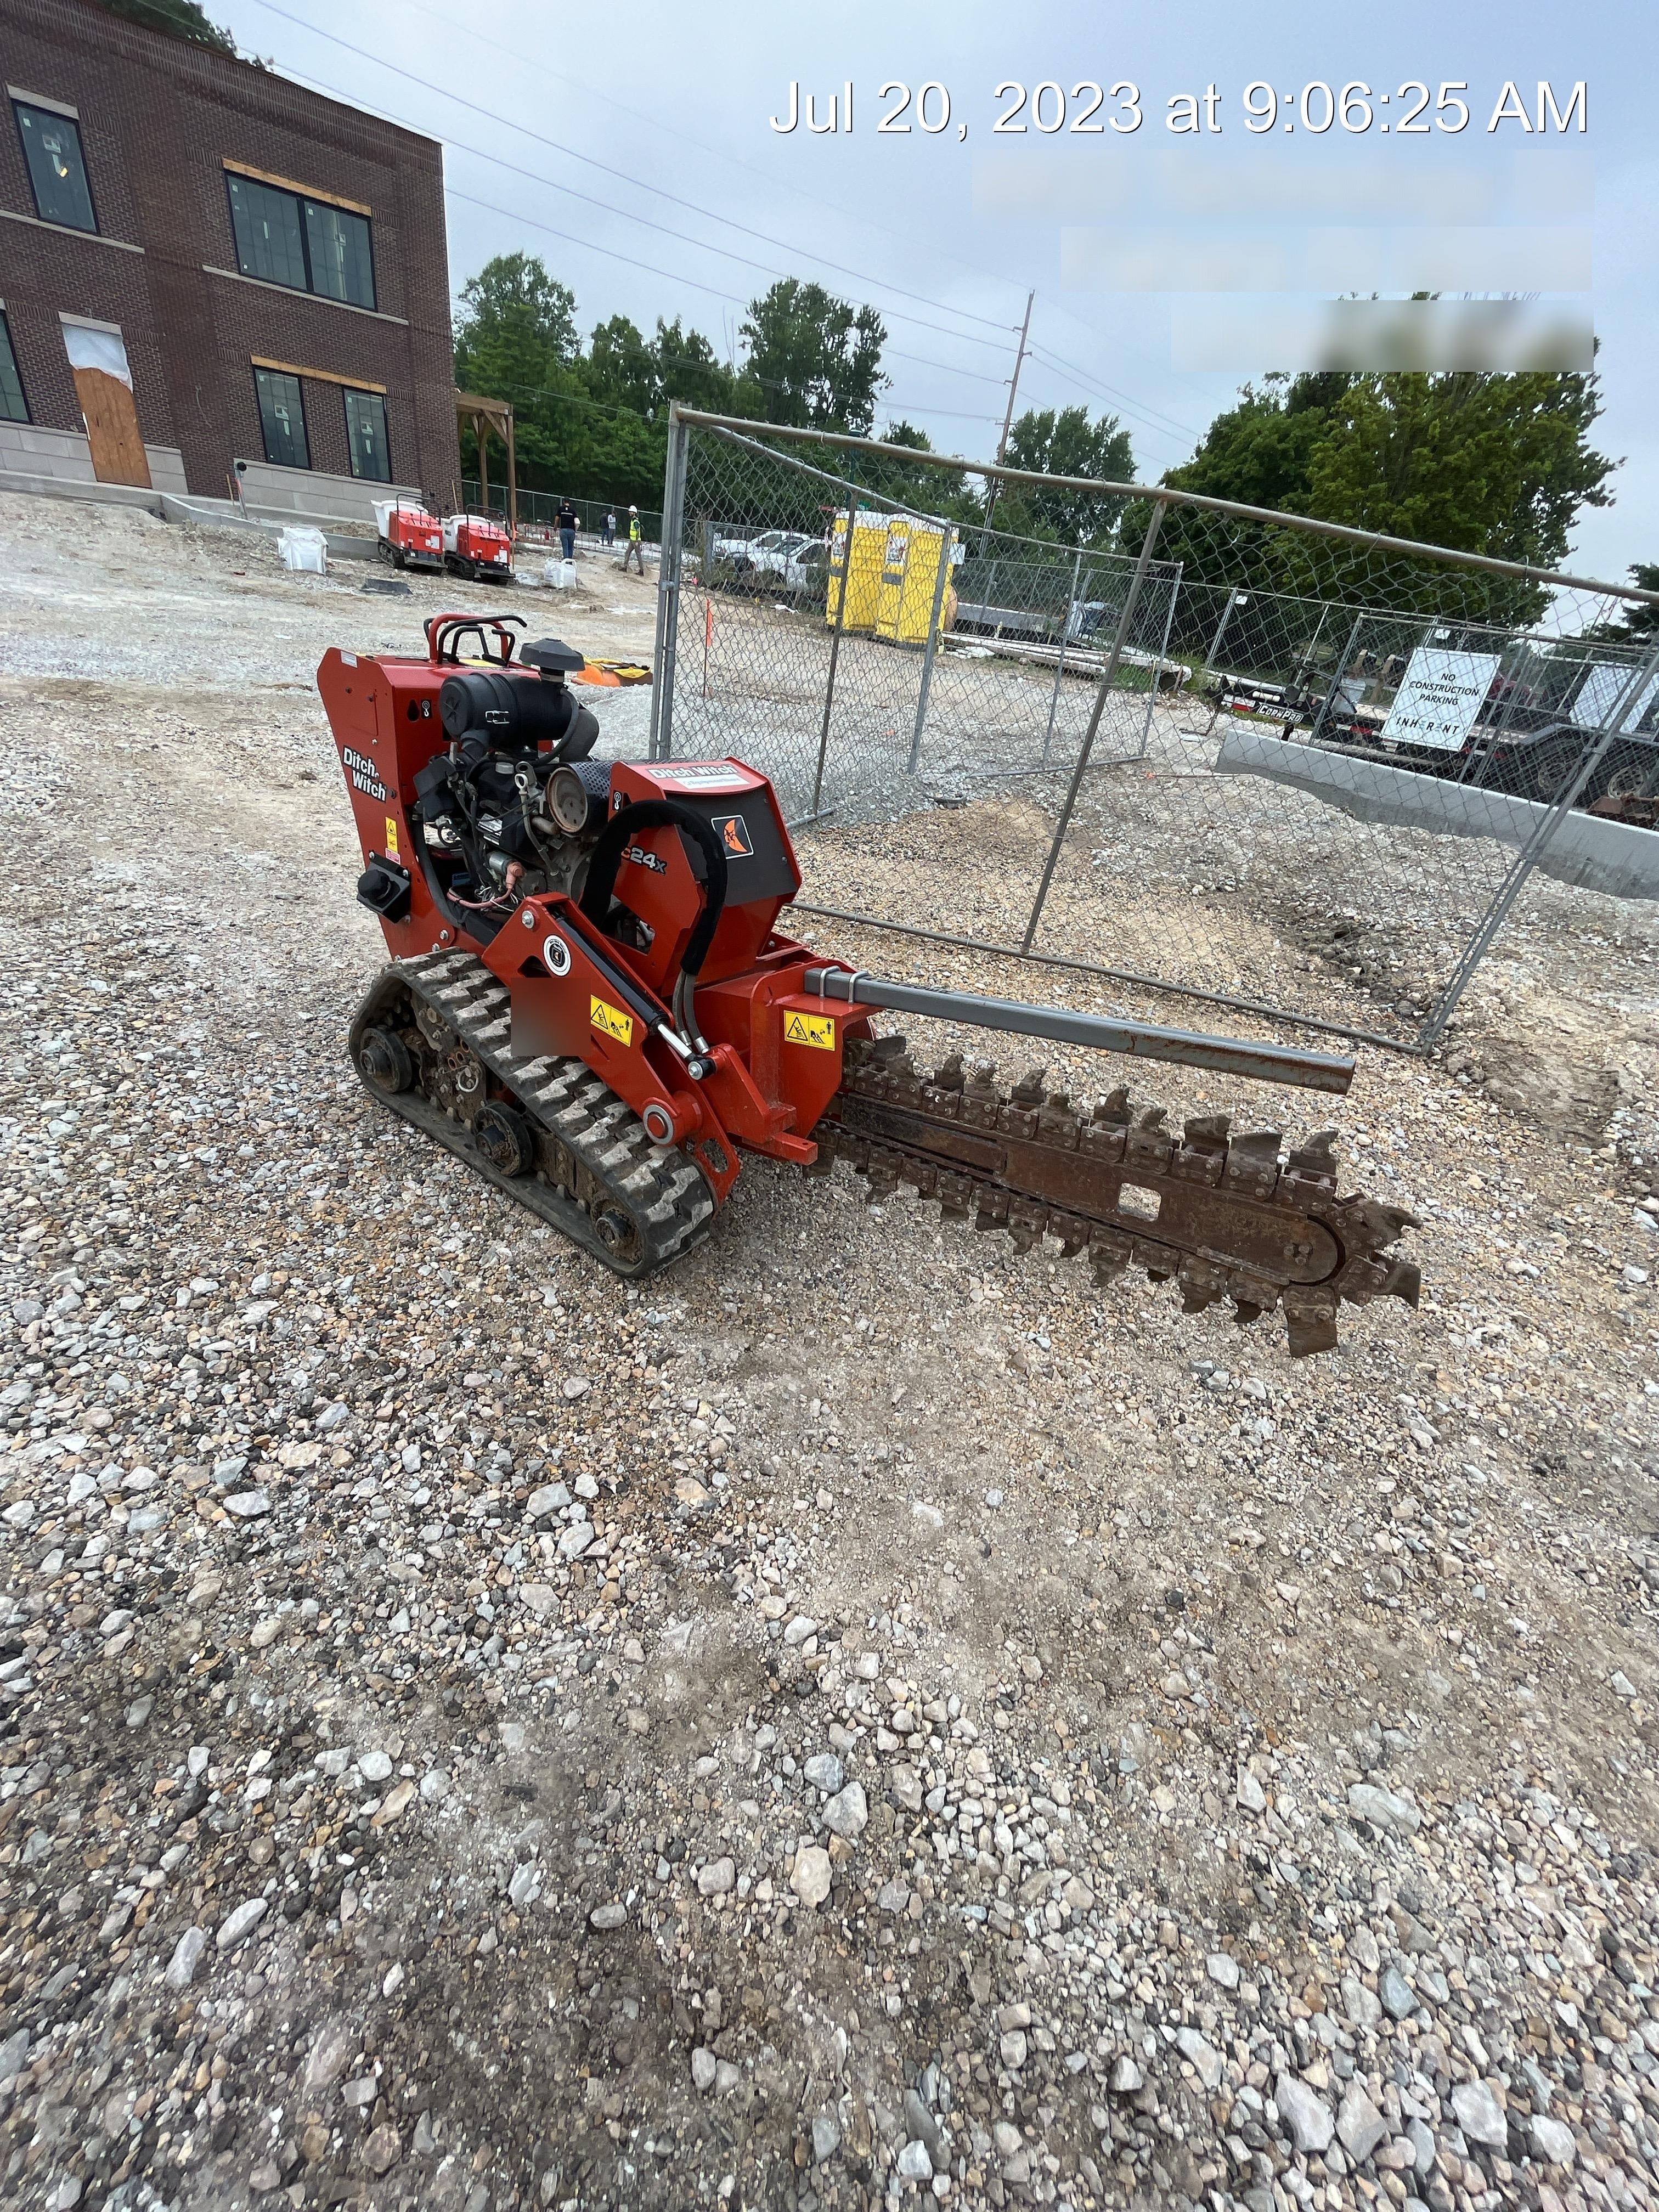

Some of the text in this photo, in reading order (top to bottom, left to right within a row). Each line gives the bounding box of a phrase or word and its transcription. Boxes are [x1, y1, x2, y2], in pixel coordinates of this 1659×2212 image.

[1409, 681, 1479, 696] CONSTRUCTION
[1419, 693, 1458, 706] PARKING
[343, 746, 375, 777] Ditch
[647, 765, 738, 778] Ditch Witch
[352, 769, 386, 802] Witch
